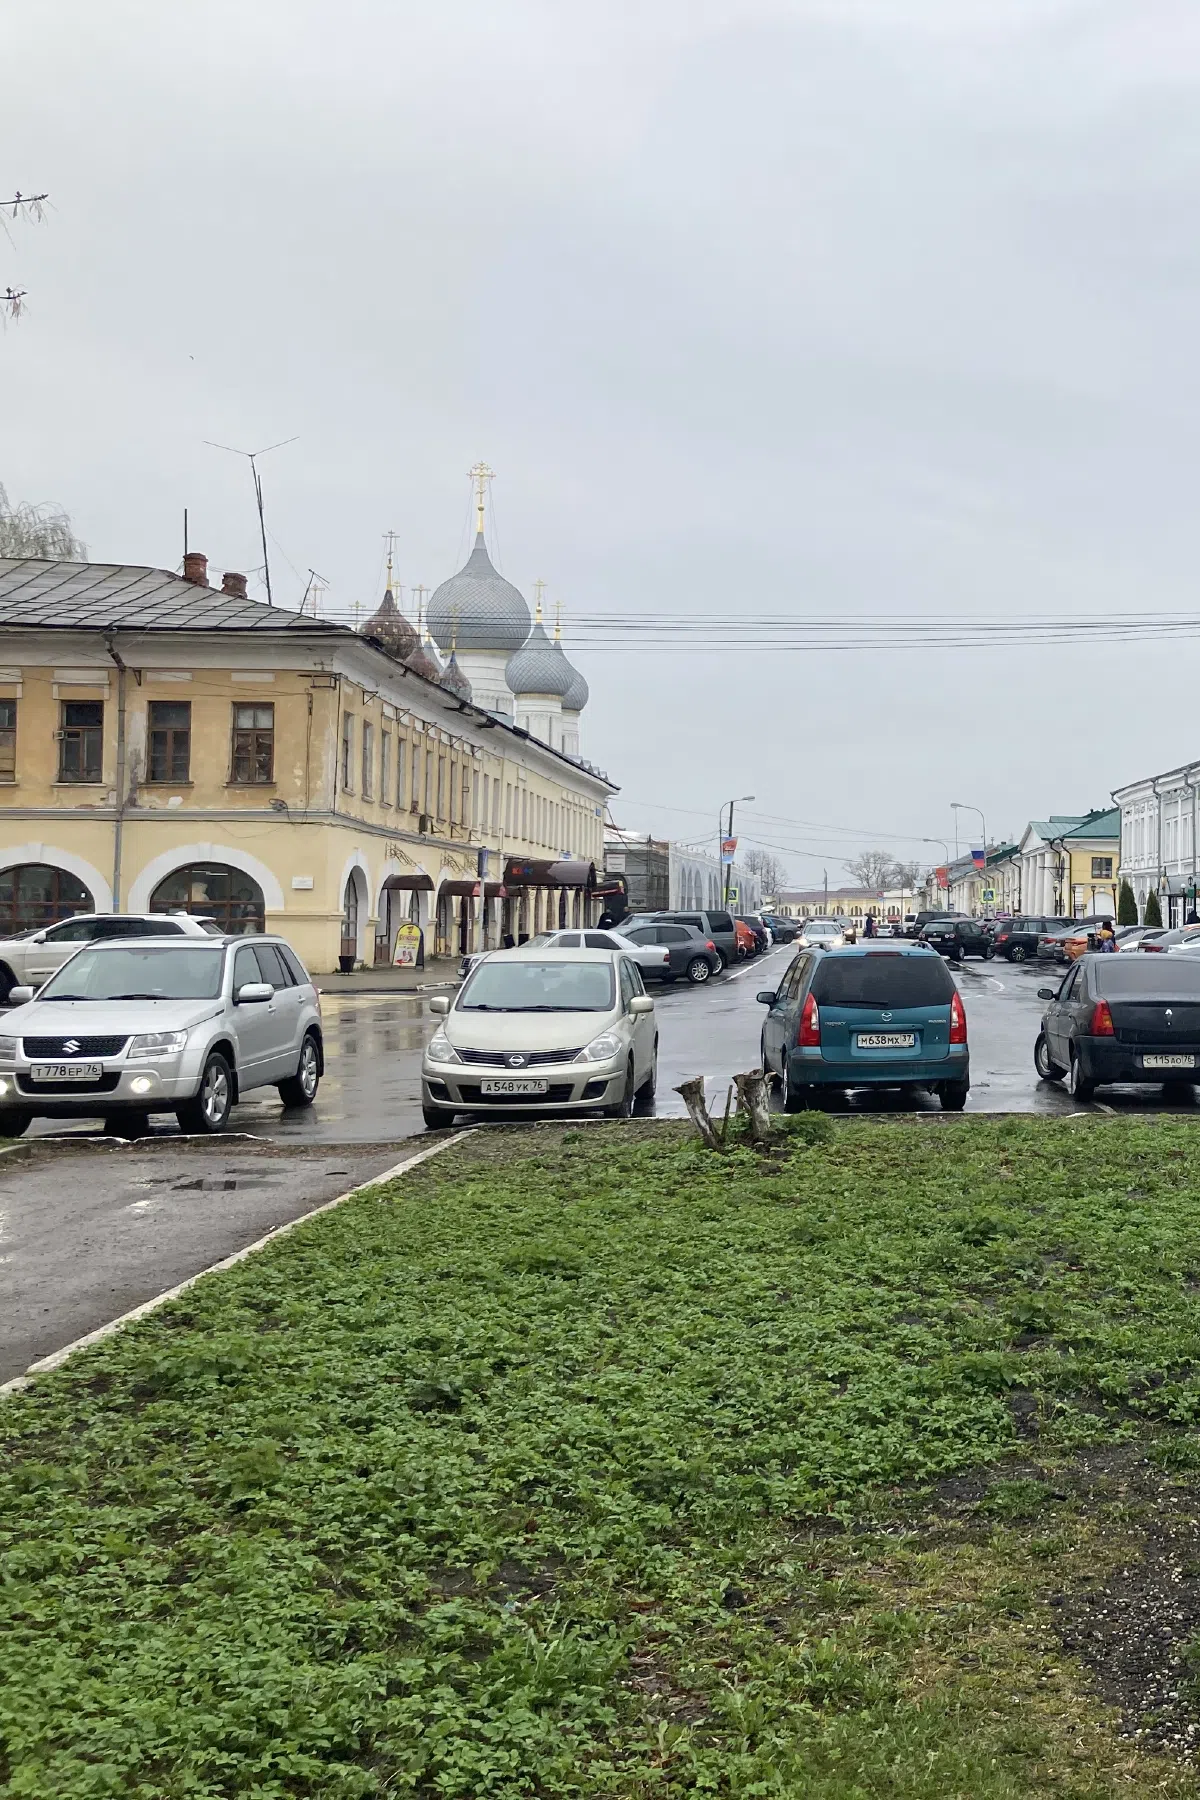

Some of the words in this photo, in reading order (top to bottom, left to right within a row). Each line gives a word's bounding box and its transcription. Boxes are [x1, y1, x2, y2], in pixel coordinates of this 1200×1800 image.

[861, 1035, 900, 1045] М638МХ
[902, 1034, 912, 1042] 37
[1184, 1055, 1192, 1063] 76
[36, 1066, 83, 1077] Т778ЕР
[86, 1064, 98, 1073] 76
[485, 1081, 529, 1092] А548УК
[532, 1081, 543, 1089] 76
